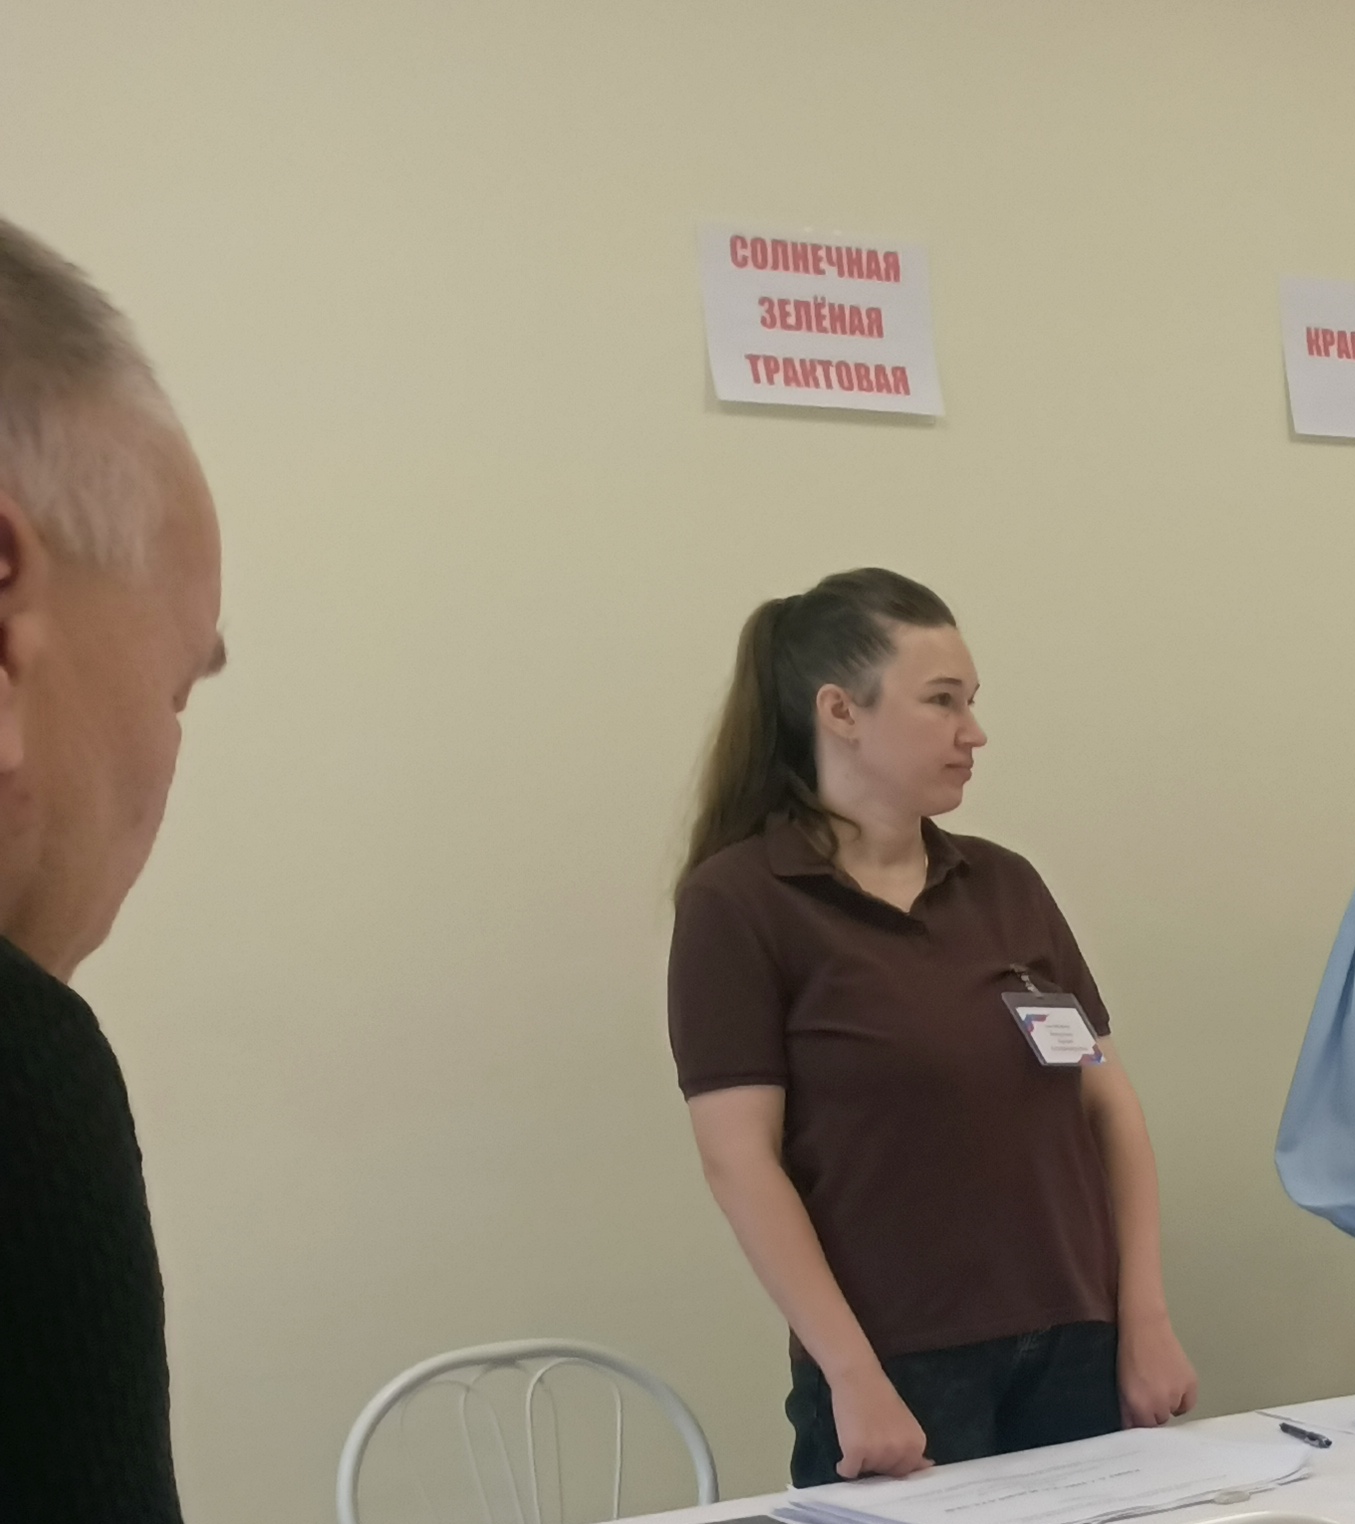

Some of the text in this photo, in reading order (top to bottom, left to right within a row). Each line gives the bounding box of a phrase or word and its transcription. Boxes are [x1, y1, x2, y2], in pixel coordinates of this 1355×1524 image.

[729, 235, 901, 284] СОЛНЕЧНАЯ
[757, 296, 884, 339] ЗЕЛЁНАЯ
[745, 354, 911, 396] ТРАКТОВАЯ
